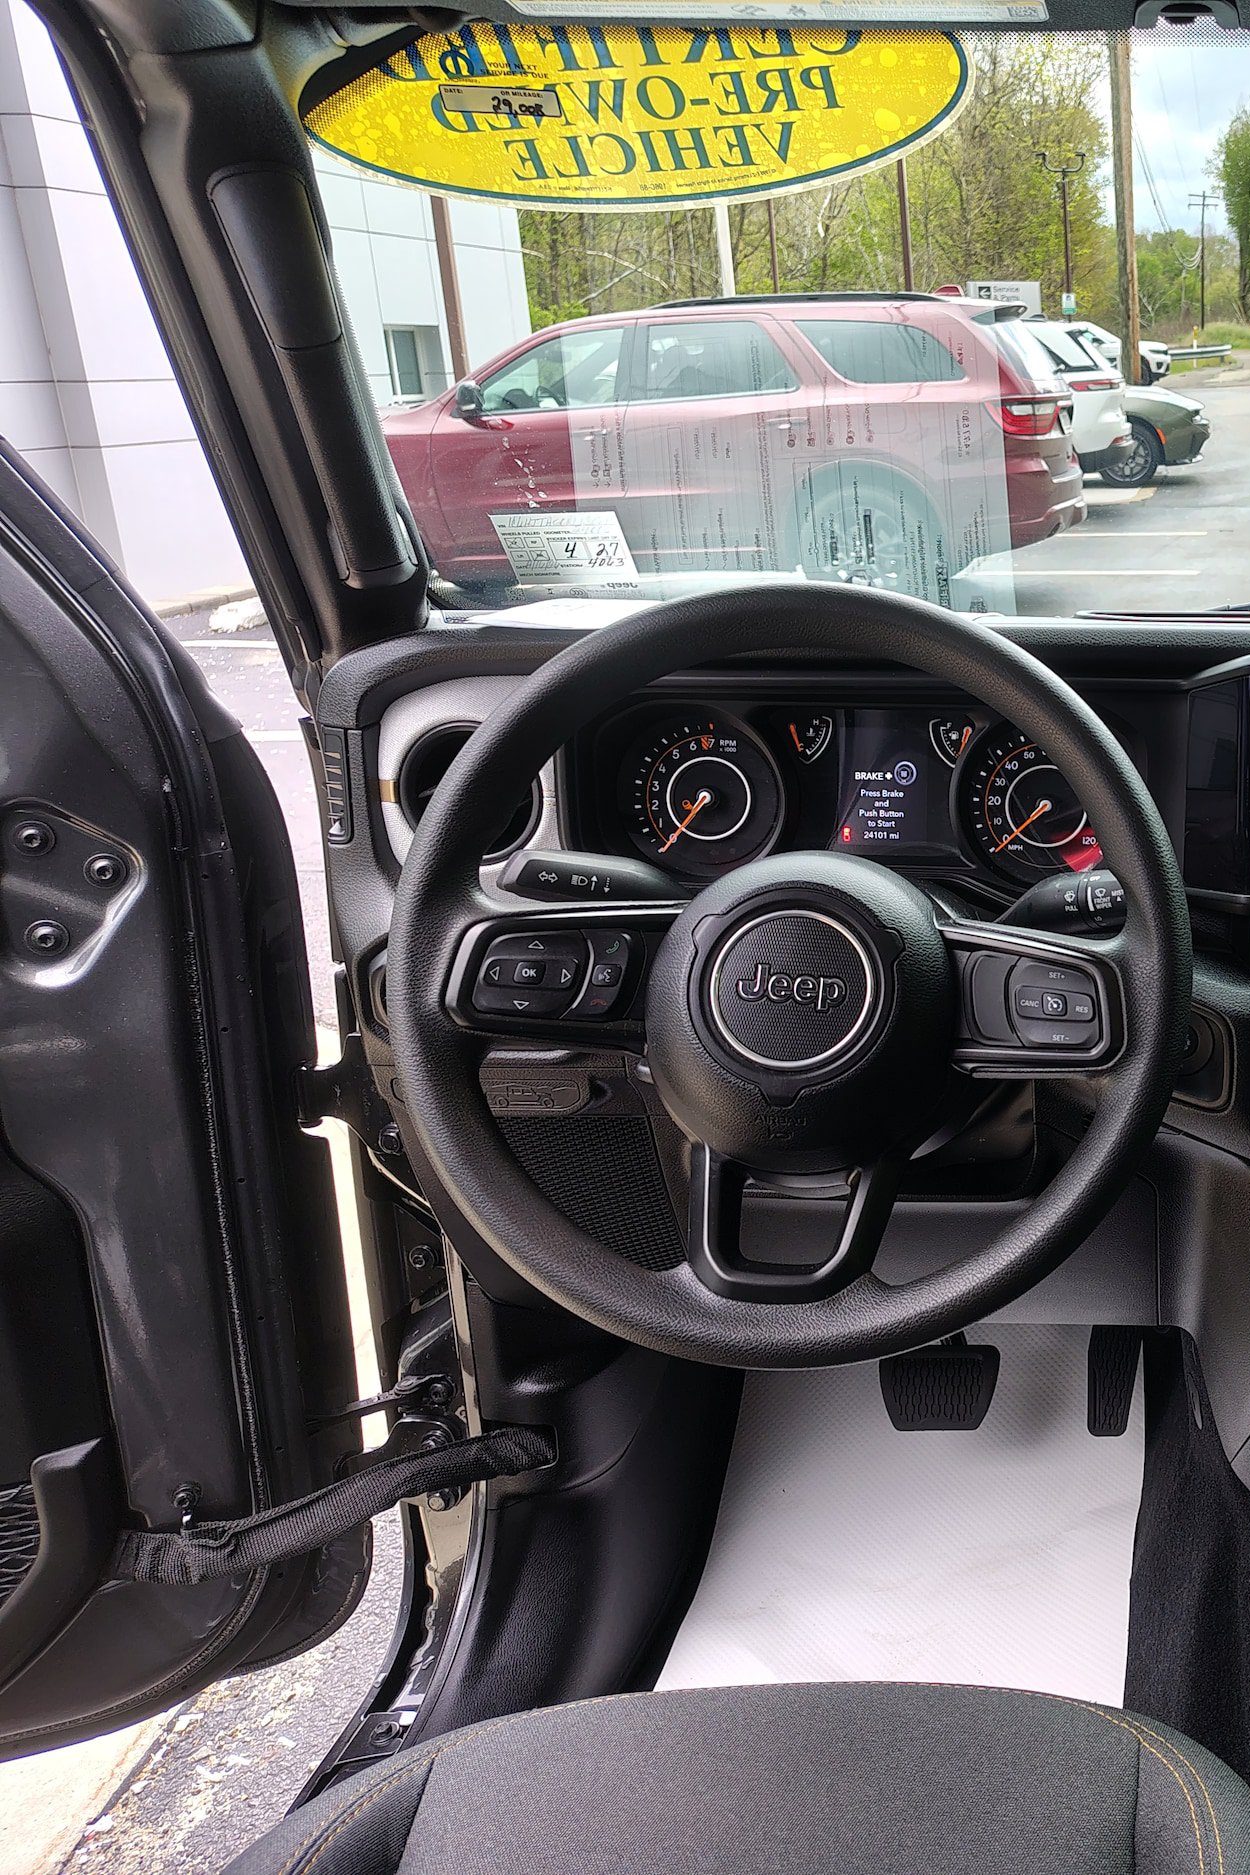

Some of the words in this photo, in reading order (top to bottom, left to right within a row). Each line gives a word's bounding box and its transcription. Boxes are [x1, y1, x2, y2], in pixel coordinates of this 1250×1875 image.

[488, 62, 511, 70] YOUR
[514, 63, 537, 71] NEXT
[511, 91, 544, 99] MILEAGE:
[993, 285, 1020, 293] Service
[564, 541, 577, 559] 4
[597, 542, 619, 557] 27
[813, 719, 820, 727] H
[689, 740, 697, 751] 6
[708, 738, 715, 748] 7
[720, 739, 737, 747] RPM
[672, 749, 680, 760] 5
[1023, 751, 1035, 760] 50
[658, 763, 666, 774] 4
[1005, 760, 1019, 770] 40
[854, 771, 884, 781] BRAKE
[994, 777, 1006, 786] 30
[652, 781, 660, 792] 3
[860, 789, 881, 798] Press
[882, 789, 904, 798] Brake
[874, 799, 890, 808] and
[988, 795, 1001, 805] 20
[651, 799, 660, 811] 2
[859, 809, 878, 818] Push
[879, 809, 904, 818] Button
[868, 820, 876, 828] to
[877, 820, 895, 828] Start
[993, 817, 1003, 825] 10
[863, 831, 888, 840] 24101
[889, 831, 900, 840] mi
[1082, 836, 1096, 845] 120
[1111, 888, 1125, 897] MIST
[1094, 896, 1111, 904] FRONT
[1096, 902, 1113, 910] WIPER
[521, 968, 537, 978] OK
[1048, 971, 1066, 979] SET+
[736, 962, 849, 1010] Jeep
[1020, 1000, 1040, 1008] CANC
[1075, 1005, 1089, 1014] RES
